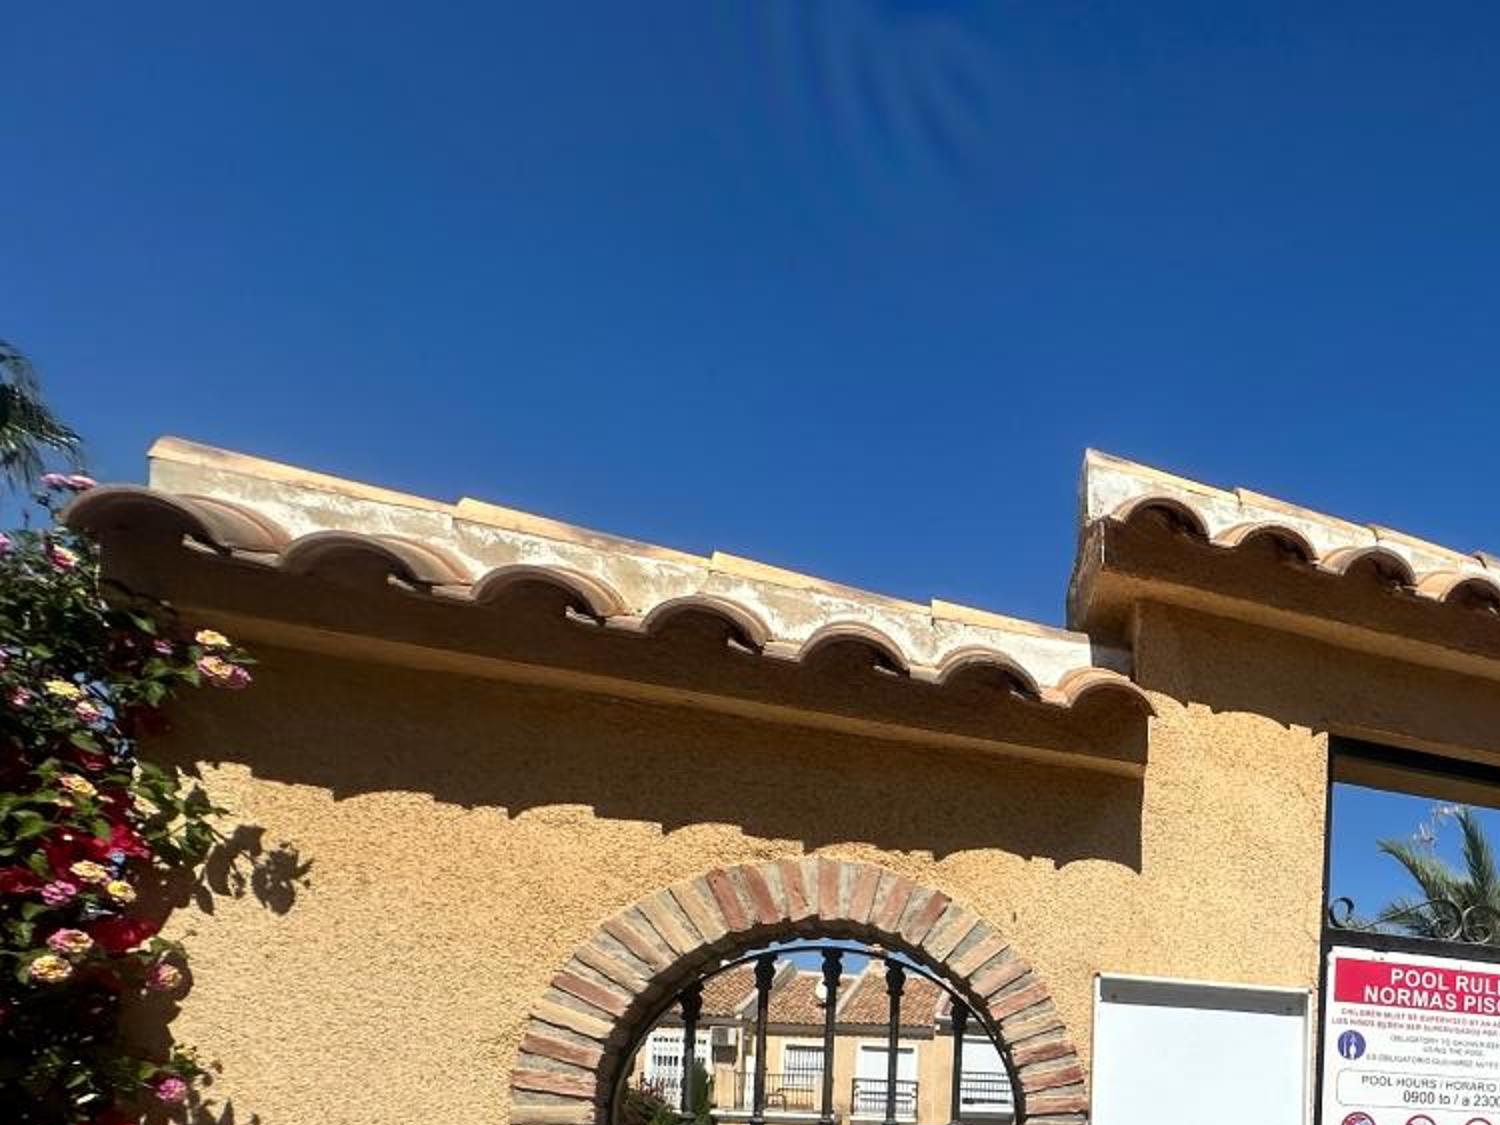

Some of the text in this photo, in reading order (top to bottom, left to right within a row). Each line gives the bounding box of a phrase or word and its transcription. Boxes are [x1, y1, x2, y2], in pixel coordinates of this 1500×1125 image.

[1391, 968, 1450, 989] POOL
[1364, 986, 1457, 1010] NORMAS
[1331, 1017, 1348, 1025] LOS
[1341, 1007, 1382, 1017] CHILDREN
[1383, 1011, 1405, 1020] MUST
[1420, 1014, 1468, 1026] SUPERVISED
[1390, 1034, 1439, 1044] OBLIGATORY
[1362, 1075, 1392, 1087] POOL
[1396, 1078, 1437, 1090] HOURS
[1446, 1081, 1497, 1093] HORARIO
[1403, 1090, 1435, 1104] 0900
[1439, 1093, 1450, 1105] to
[1462, 1096, 1470, 1106] a
